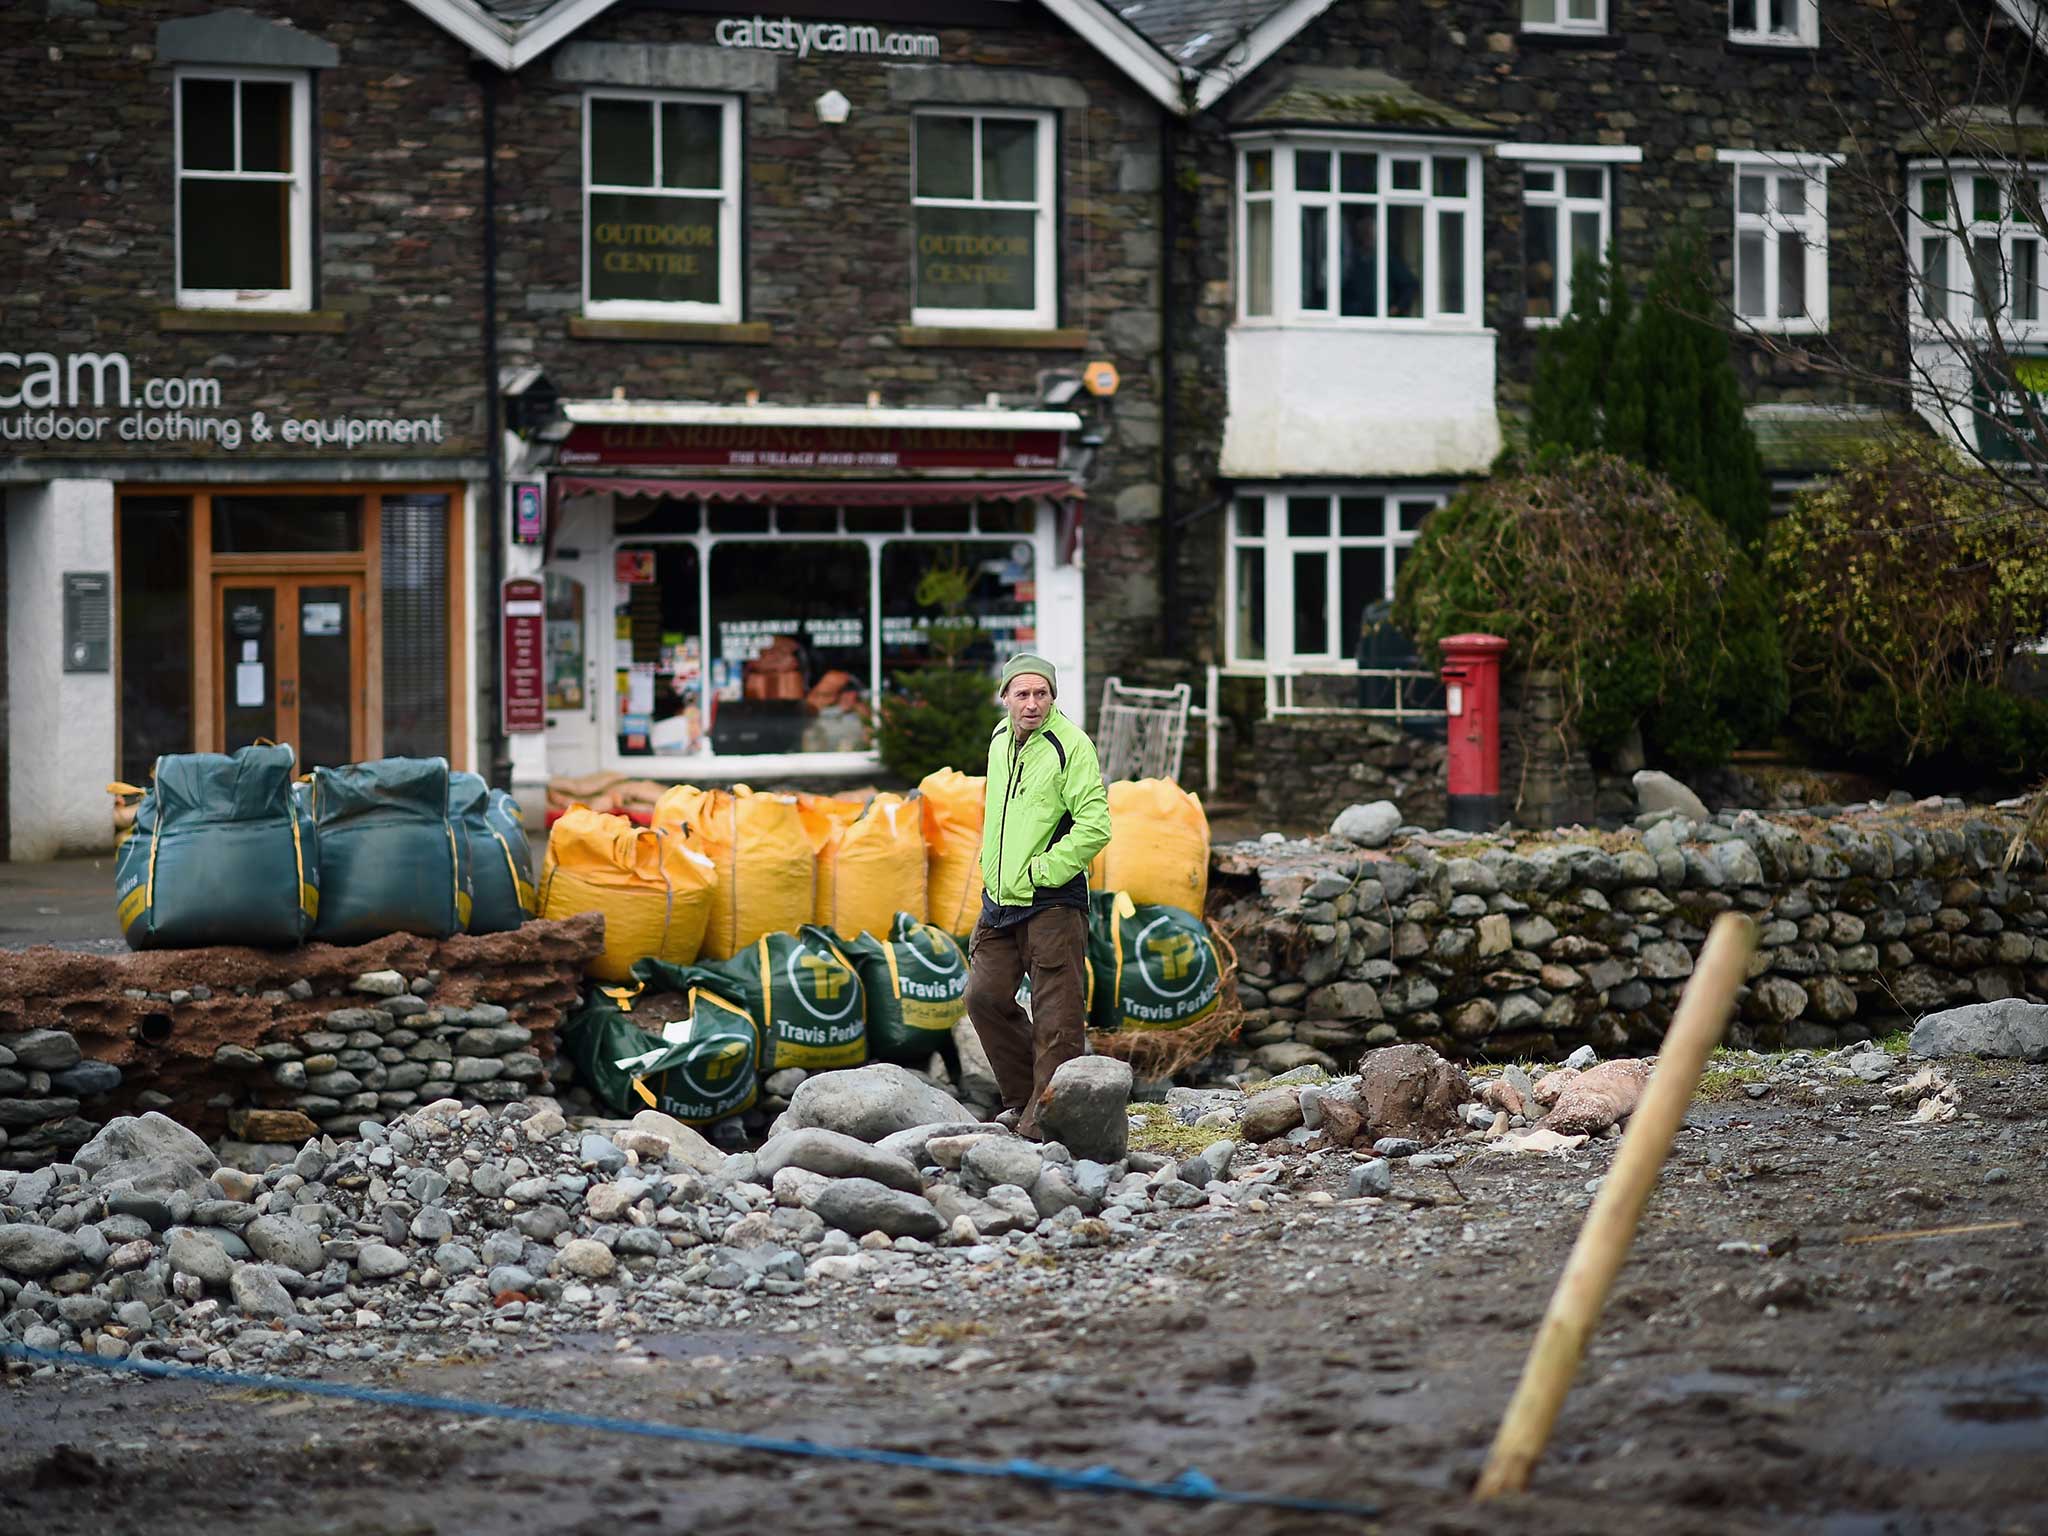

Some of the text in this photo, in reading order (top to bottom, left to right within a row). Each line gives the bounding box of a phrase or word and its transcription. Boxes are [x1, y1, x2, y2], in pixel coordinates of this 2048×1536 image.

[715, 15, 940, 58] catstycam.com
[594, 223, 713, 246] OUTDOOR
[919, 235, 1028, 256] OUTDOOR
[603, 252, 700, 275] CENTRE
[926, 264, 1014, 284] CENTRE
[0, 410, 443, 450] utdoor clothing & equipment
[899, 975, 947, 998] Travis
[1124, 997, 1173, 1019] Travis
[777, 1019, 826, 1043] Travis
[663, 1095, 713, 1117] Travis
